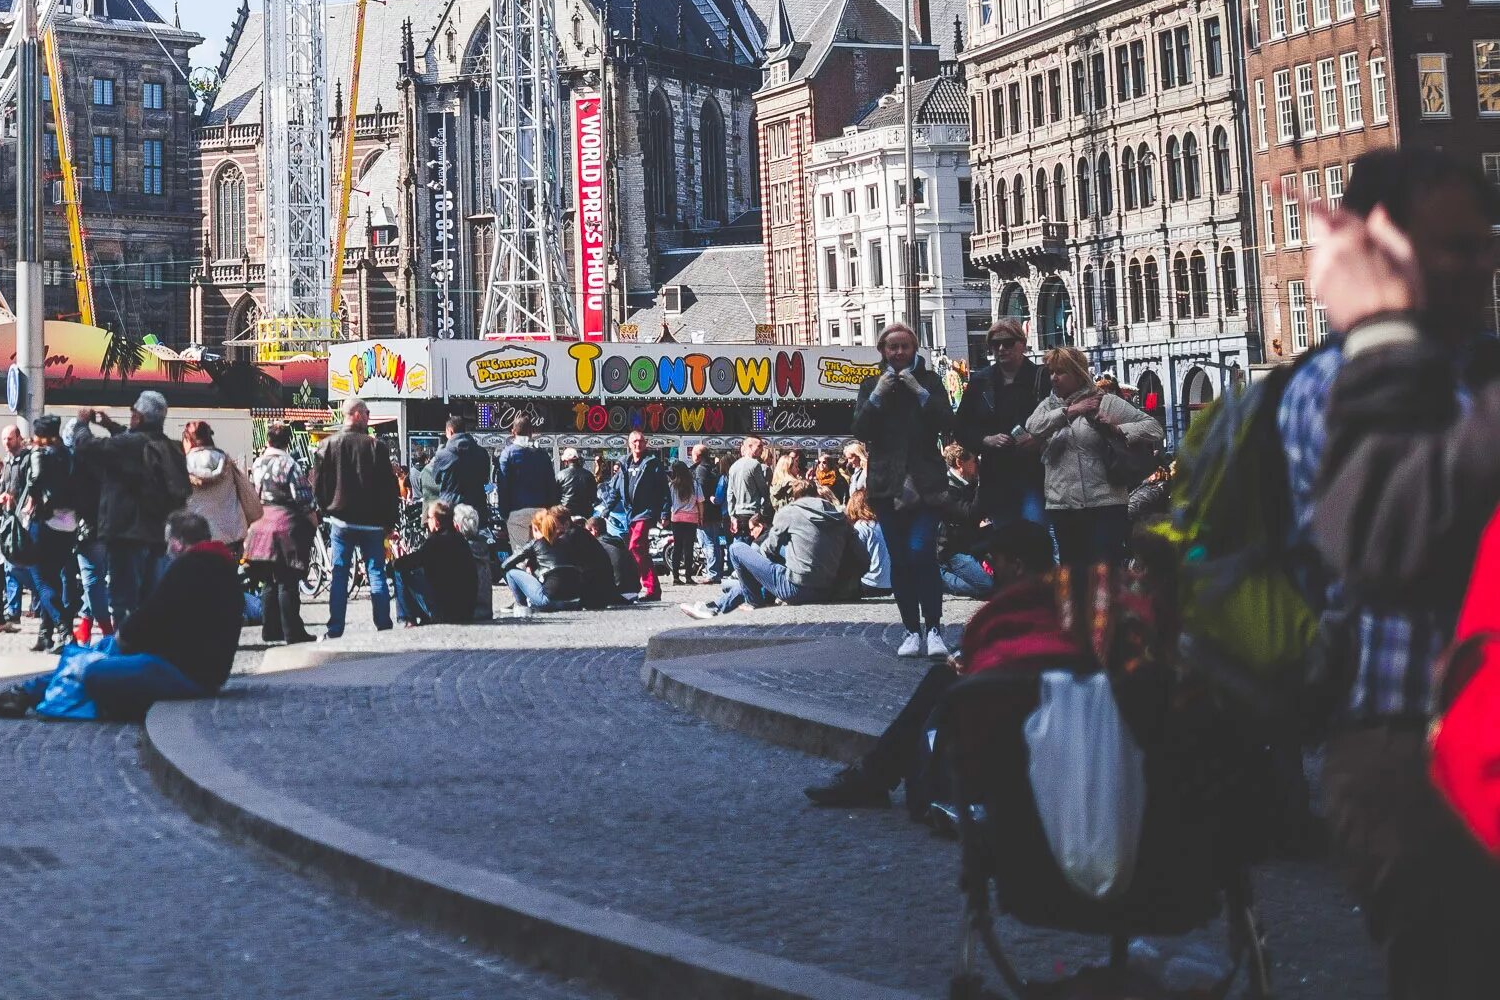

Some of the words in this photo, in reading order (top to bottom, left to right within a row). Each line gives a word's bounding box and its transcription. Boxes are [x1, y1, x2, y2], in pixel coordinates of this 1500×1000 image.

[581, 114, 601, 183] WORLD
[582, 186, 603, 244] PRESS
[349, 344, 405, 394] TOONTOWN
[476, 360, 490, 369] THE
[491, 356, 537, 370] CARTOON
[477, 368, 536, 383] PLAYROOM
[568, 342, 805, 397] TOONTOWN
[825, 361, 840, 371] THE
[841, 365, 881, 376] ORIGIN
[825, 371, 864, 384] TOONG
[572, 403, 724, 432] TOONTOWN
[773, 410, 816, 433] Claw
